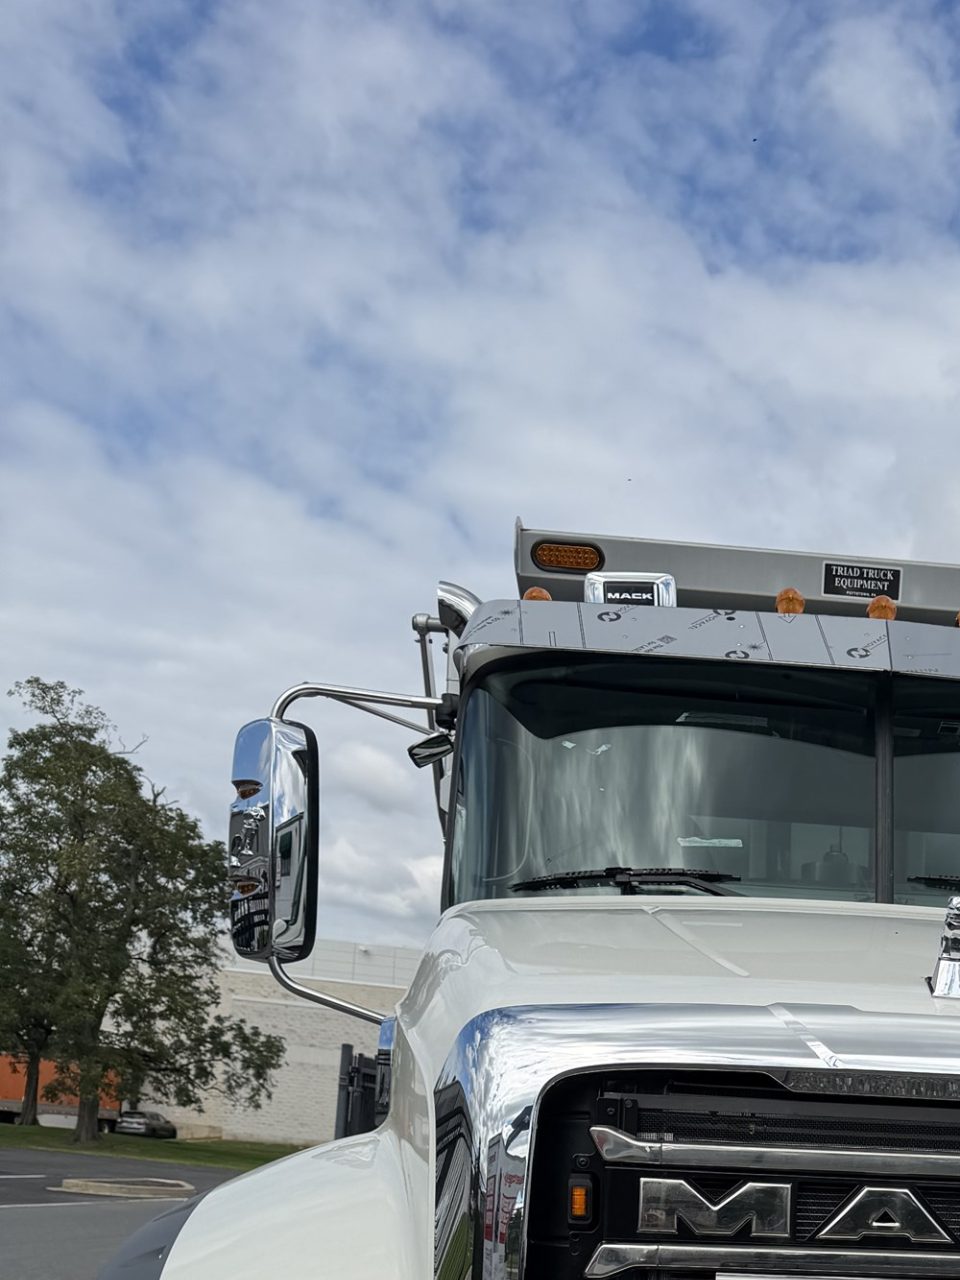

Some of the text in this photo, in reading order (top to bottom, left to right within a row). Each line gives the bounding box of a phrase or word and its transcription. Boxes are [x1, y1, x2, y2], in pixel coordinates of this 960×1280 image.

[831, 565, 894, 581] TRIAD TRUCK
[834, 577, 890, 591] EQUIPMENT
[607, 592, 653, 600] MACK
